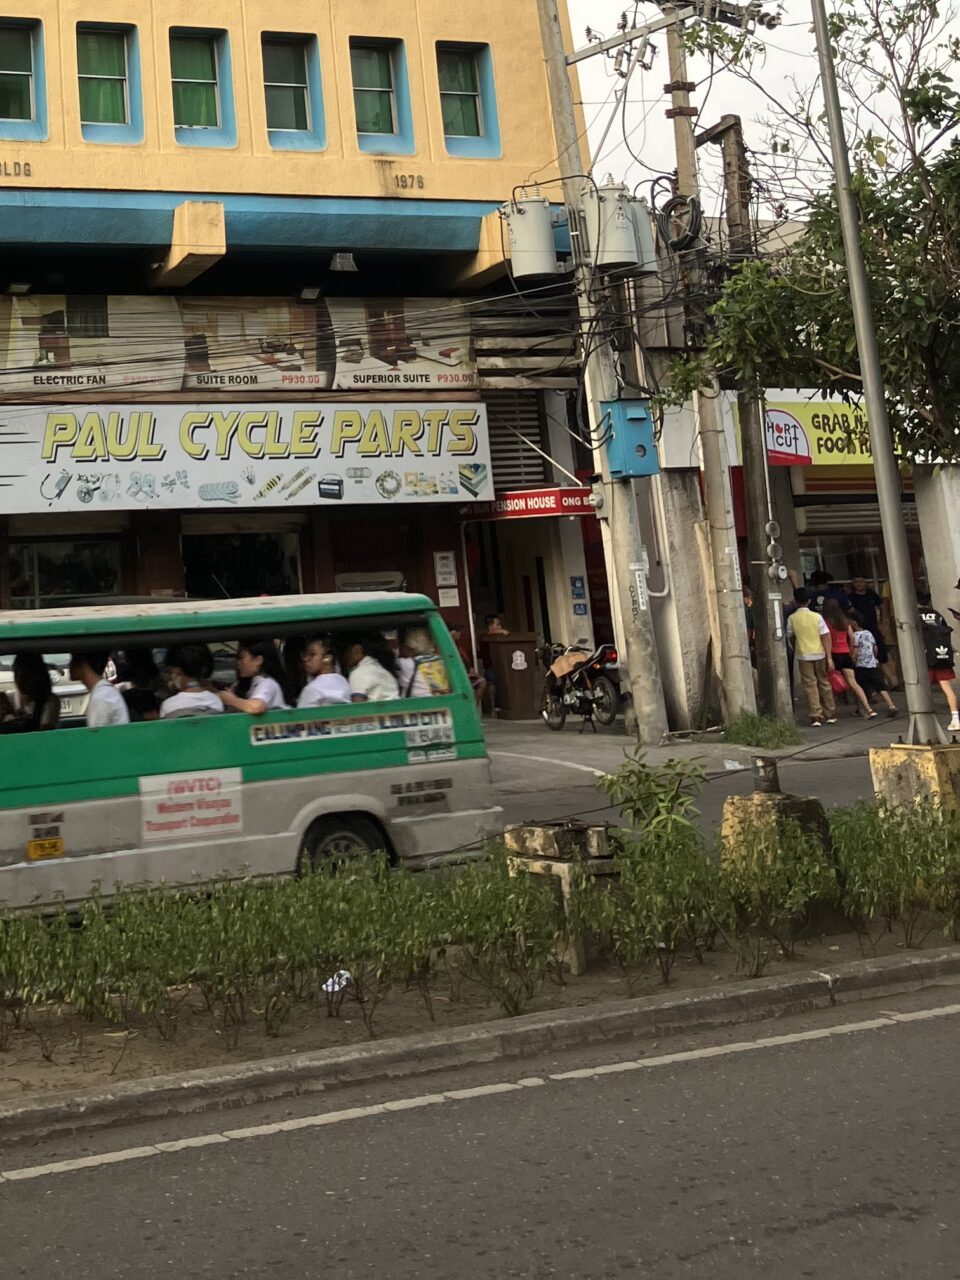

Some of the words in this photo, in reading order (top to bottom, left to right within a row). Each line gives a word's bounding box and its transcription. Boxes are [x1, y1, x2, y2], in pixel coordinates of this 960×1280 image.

[33, 375, 84, 385] ELECTRIC
[87, 375, 106, 384] FAN
[196, 375, 226, 385] SUITE
[228, 375, 258, 384] ROOM
[281, 374, 320, 384] P930.00
[353, 374, 401, 384] SUPERIOR
[403, 373, 430, 383] SUITE
[811, 413, 850, 434] GRAB
[41, 411, 166, 463] PAUL
[179, 410, 324, 460] CYCLE
[330, 409, 480, 458] PARTS
[527, 496, 556, 509] HOUSE
[562, 497, 581, 506] ONG
